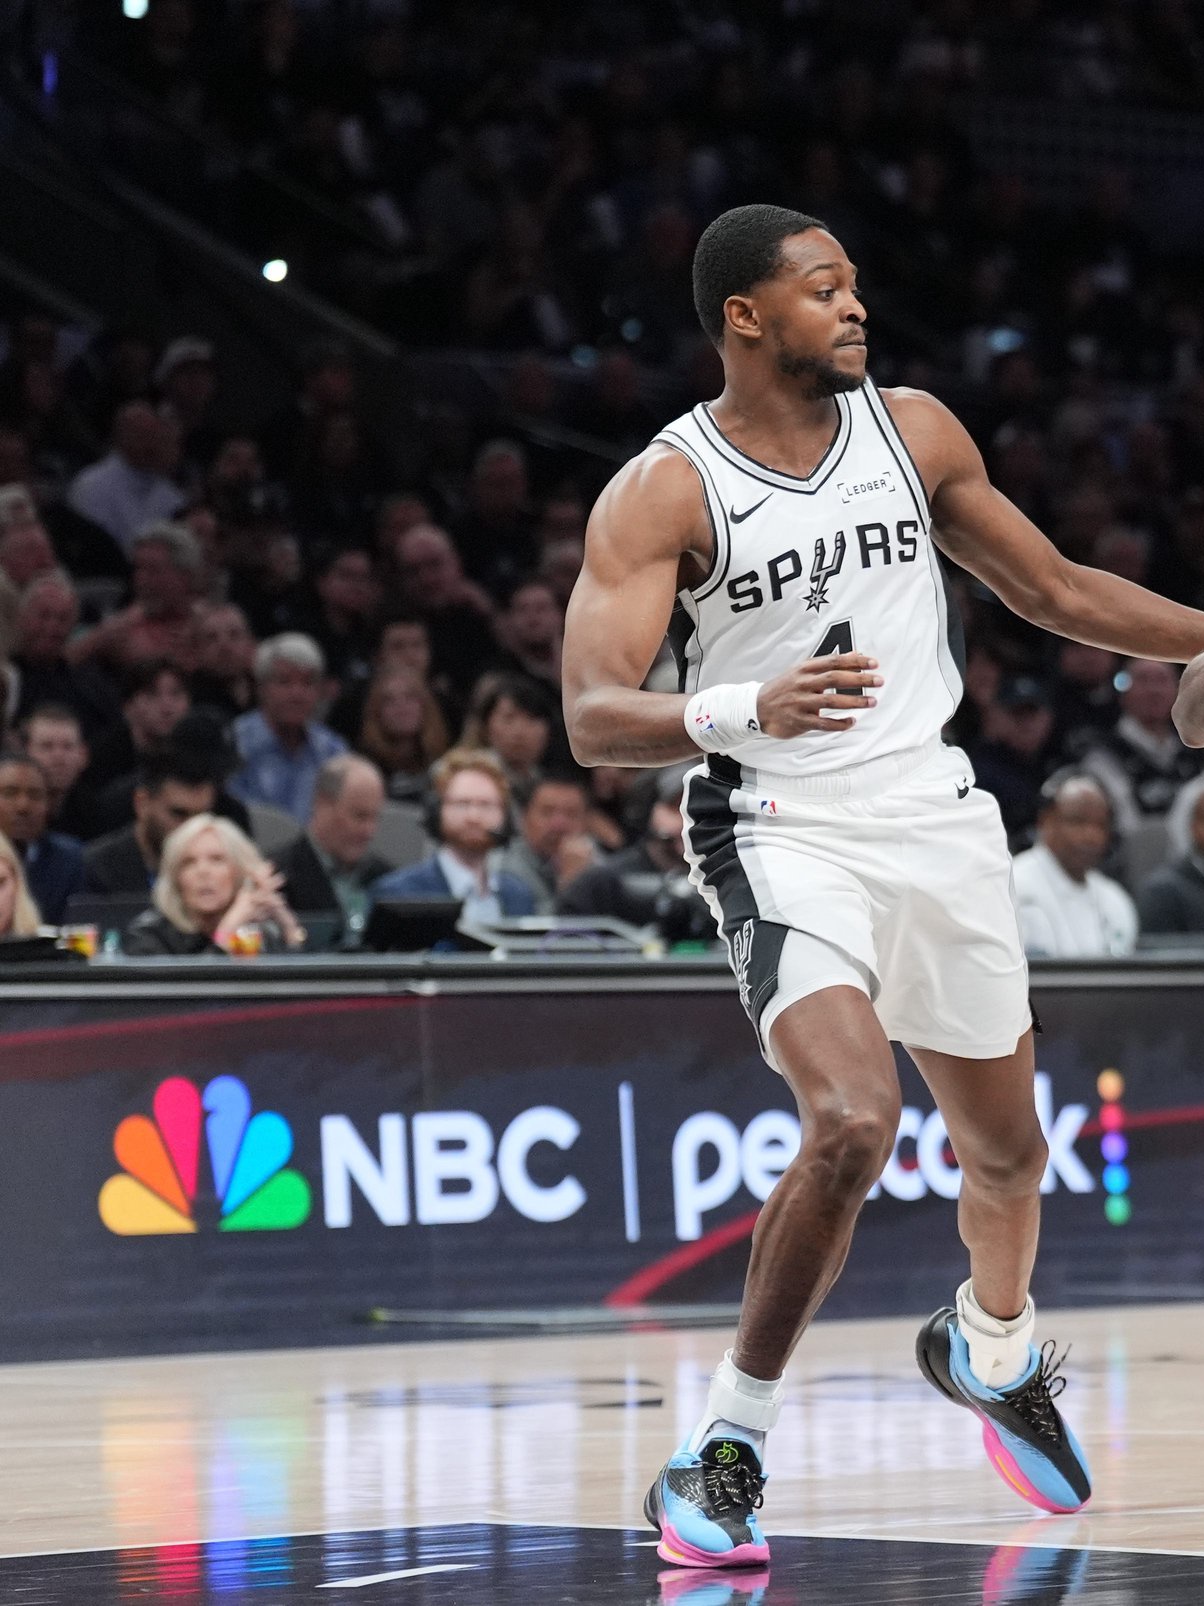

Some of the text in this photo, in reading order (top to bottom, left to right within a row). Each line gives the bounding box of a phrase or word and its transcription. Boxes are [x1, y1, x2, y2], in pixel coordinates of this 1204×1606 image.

[845, 479, 888, 497] LEDGER
[727, 519, 919, 613] SPURS
[321, 1104, 588, 1229] NBC
